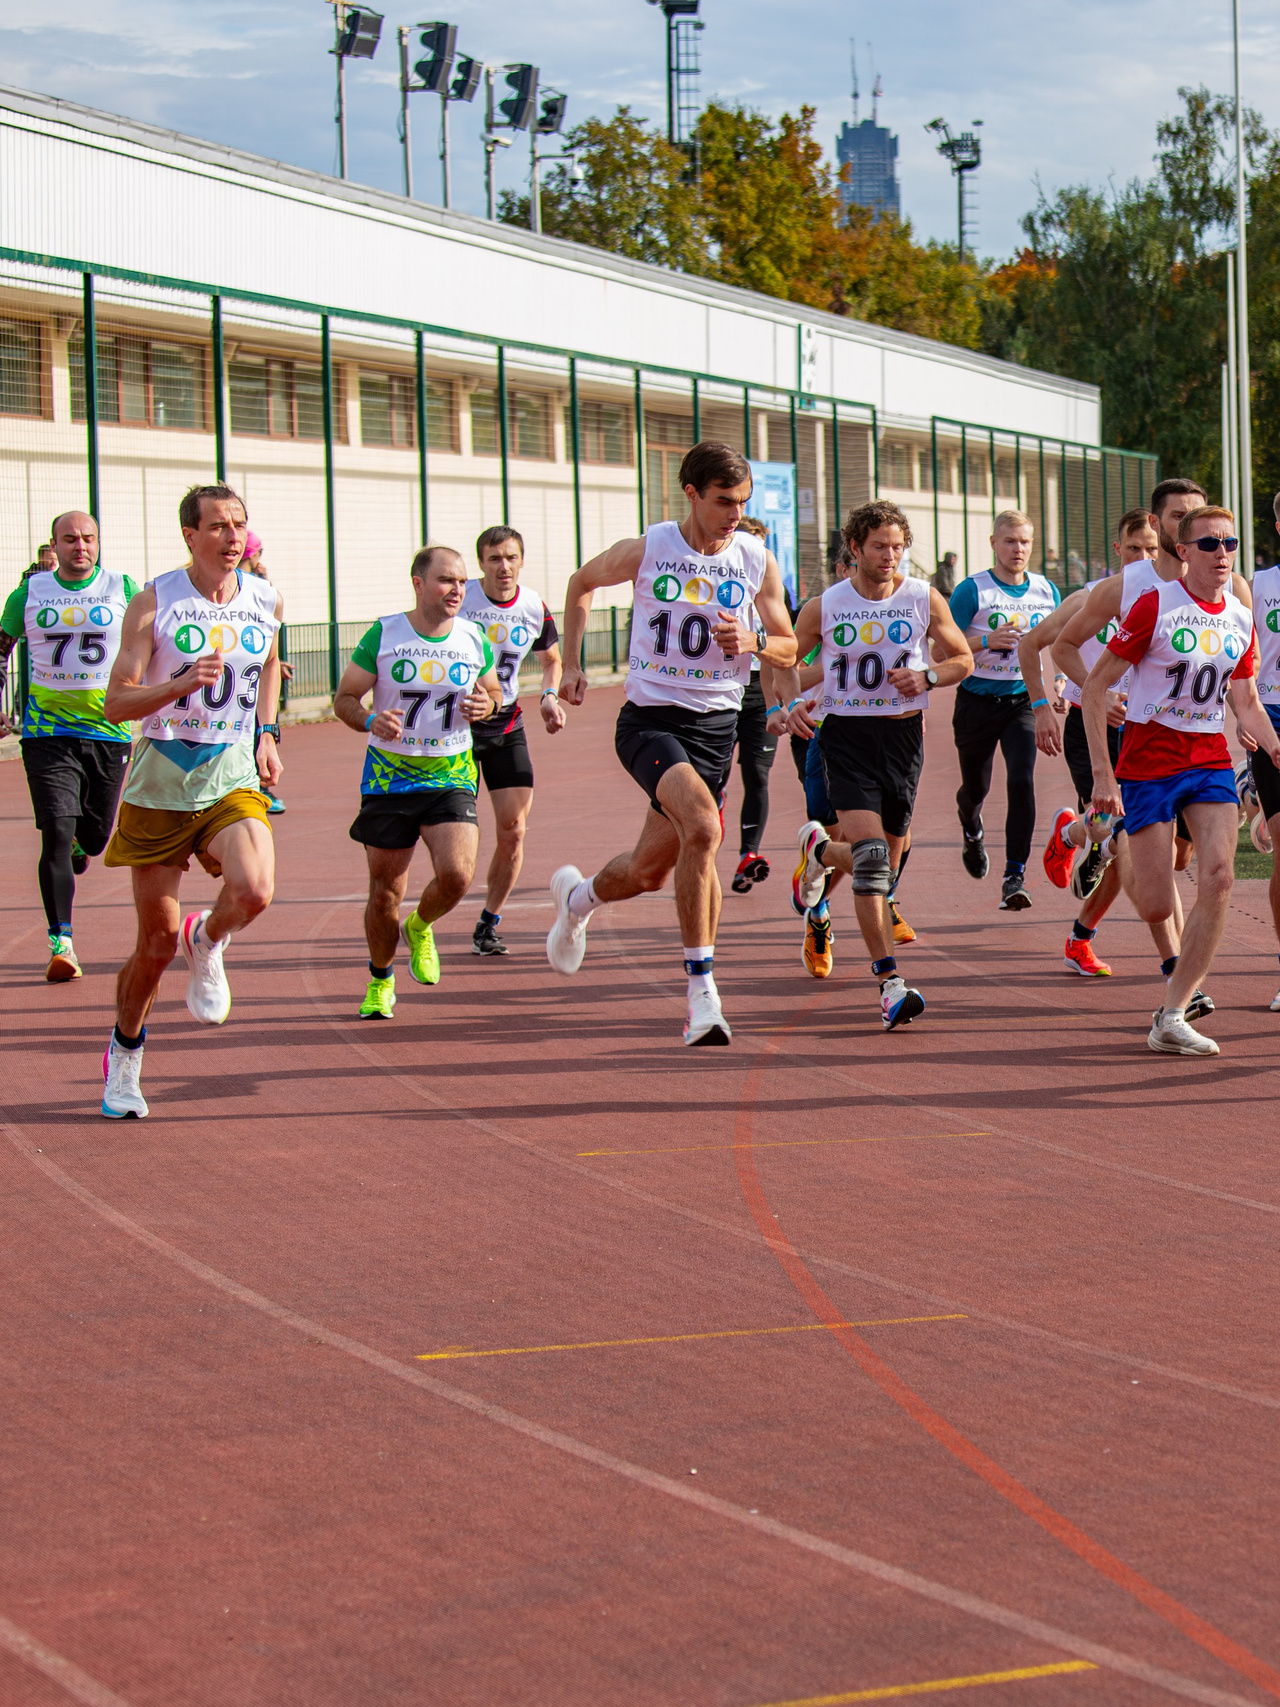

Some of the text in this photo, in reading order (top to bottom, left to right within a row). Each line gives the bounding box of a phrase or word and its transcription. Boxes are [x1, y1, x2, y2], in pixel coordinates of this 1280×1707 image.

[655, 561, 746, 579] VMARAFONE
[38, 596, 111, 607] VMARAFONE
[990, 603, 1045, 612] VMARAFONE
[173, 610, 265, 623] VMARAFONE
[466, 611, 530, 625] VMARAFONE
[833, 609, 913, 622] VMARAFONE
[1172, 615, 1238, 634] VMARAFONE
[648, 610, 734, 661] 10
[44, 632, 108, 667] 75
[393, 647, 470, 661] VMARAFONE
[496, 649, 520, 684] 5
[640, 660, 740, 680] VMARAFONE.CLUB
[400, 690, 459, 731] 71
